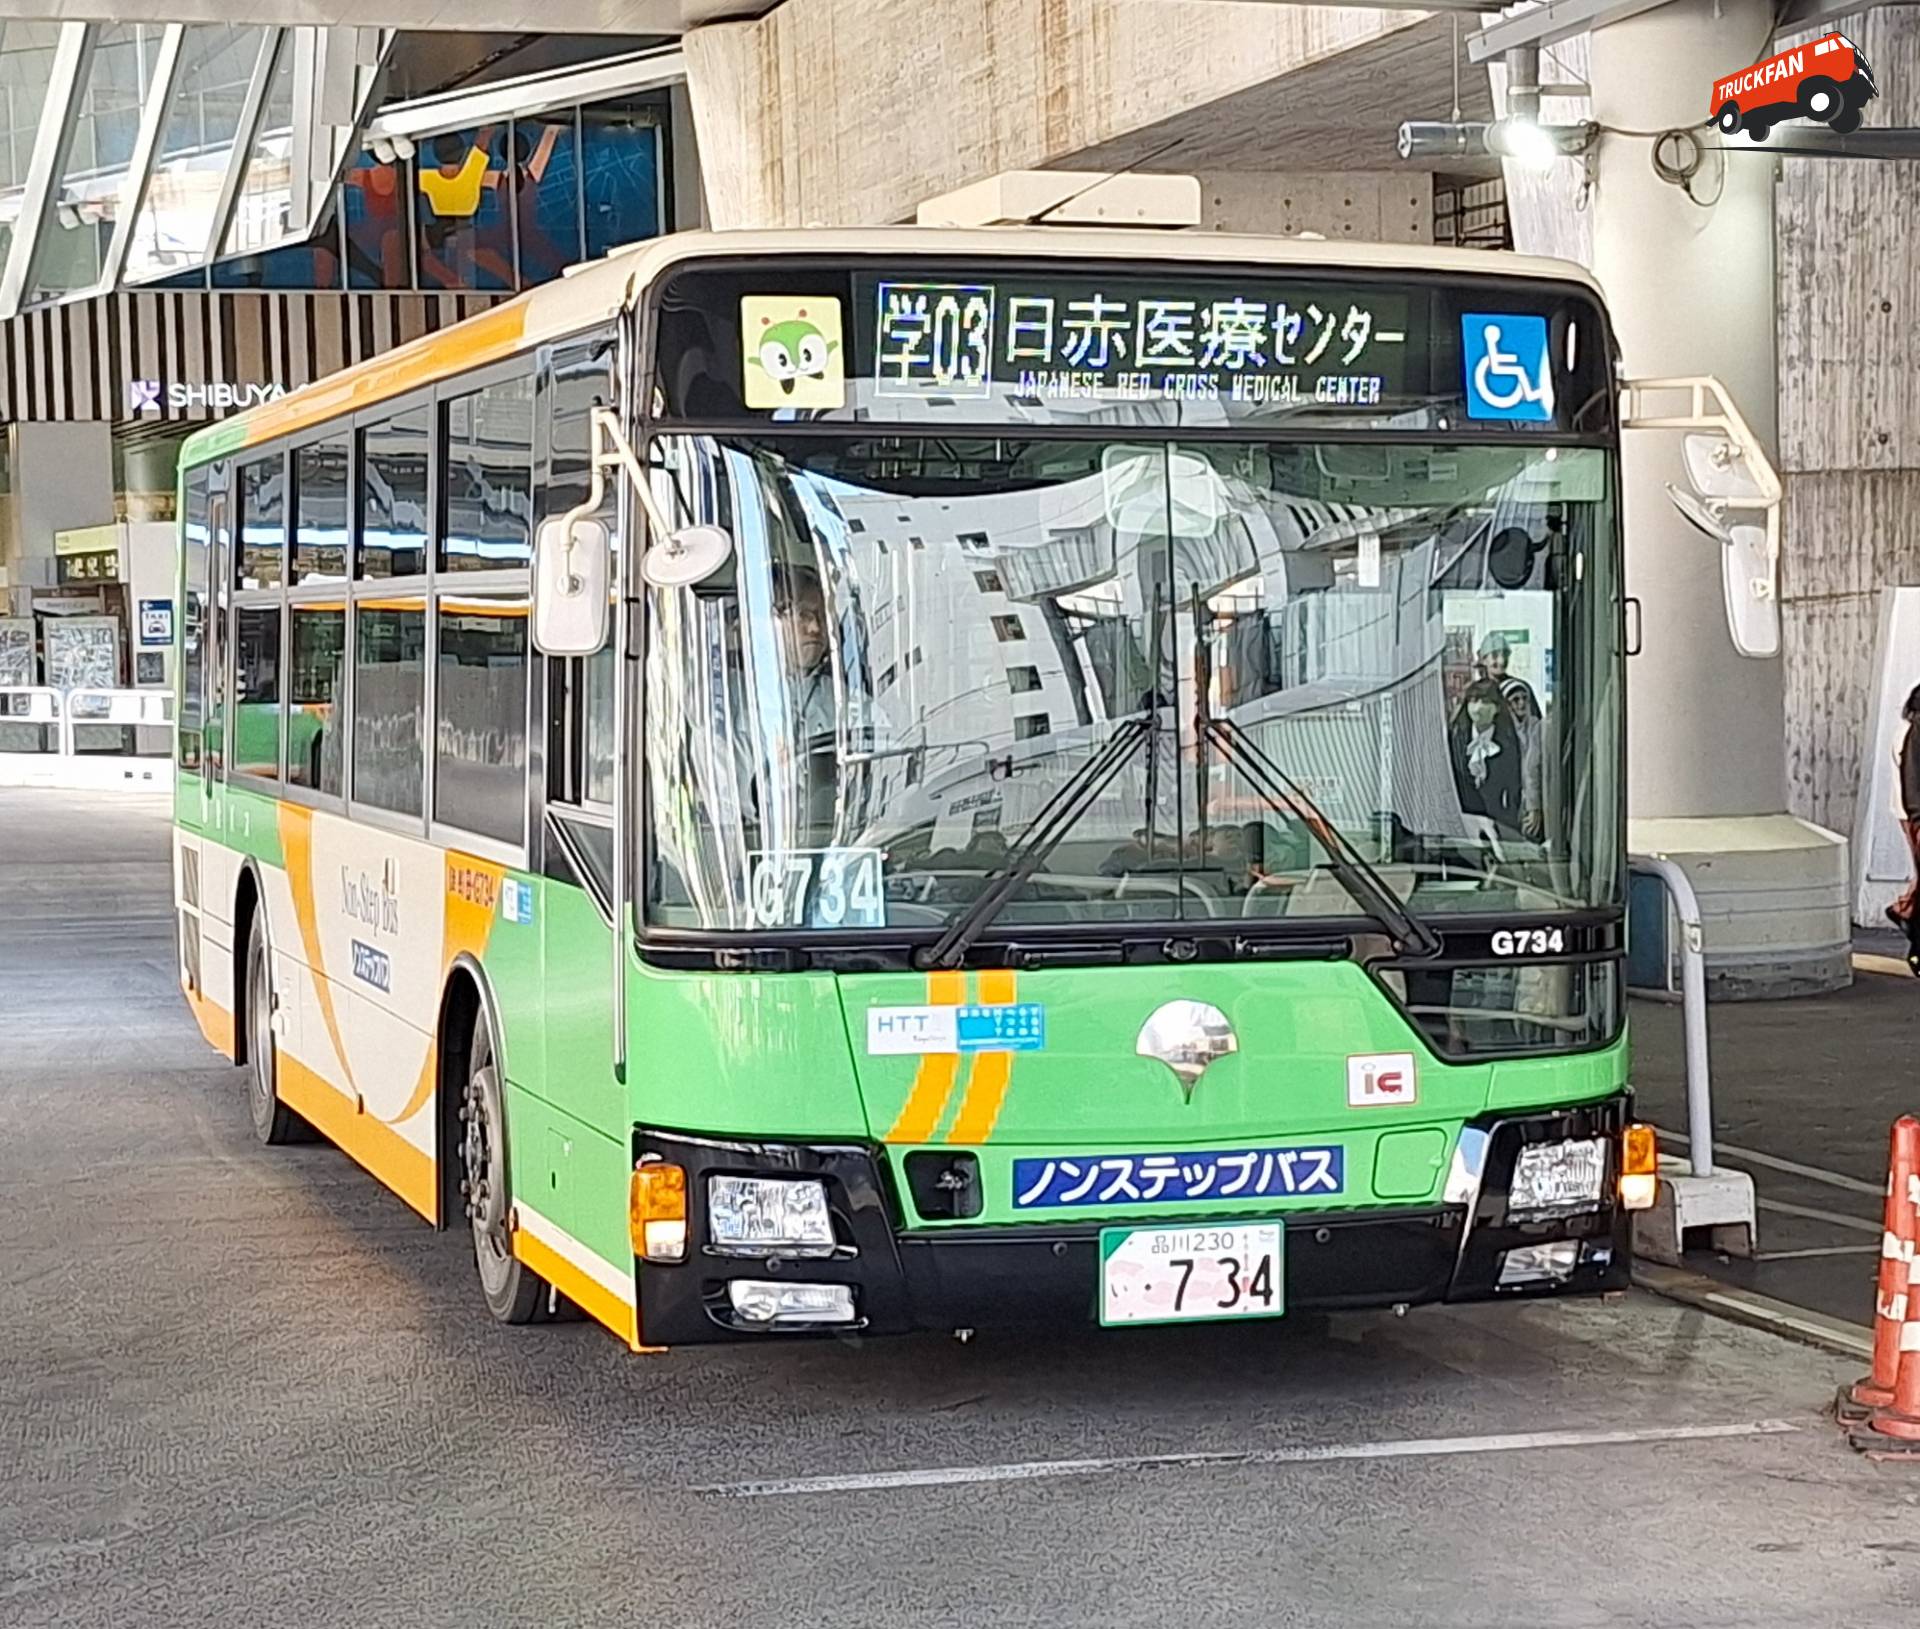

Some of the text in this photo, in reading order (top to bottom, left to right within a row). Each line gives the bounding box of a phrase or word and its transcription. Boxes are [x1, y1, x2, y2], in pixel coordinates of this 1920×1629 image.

[1005, 293, 1405, 369] 日赤医療センター
[168, 383, 286, 408] SHIBUYA
[1014, 371, 1382, 404] JAPANESE RED CROSS MEDICAL CENTER
[752, 858, 878, 927] G734
[1491, 930, 1563, 955] G734
[878, 1015, 929, 1032] HTT
[1018, 1150, 1338, 1205] ノンステップバス
